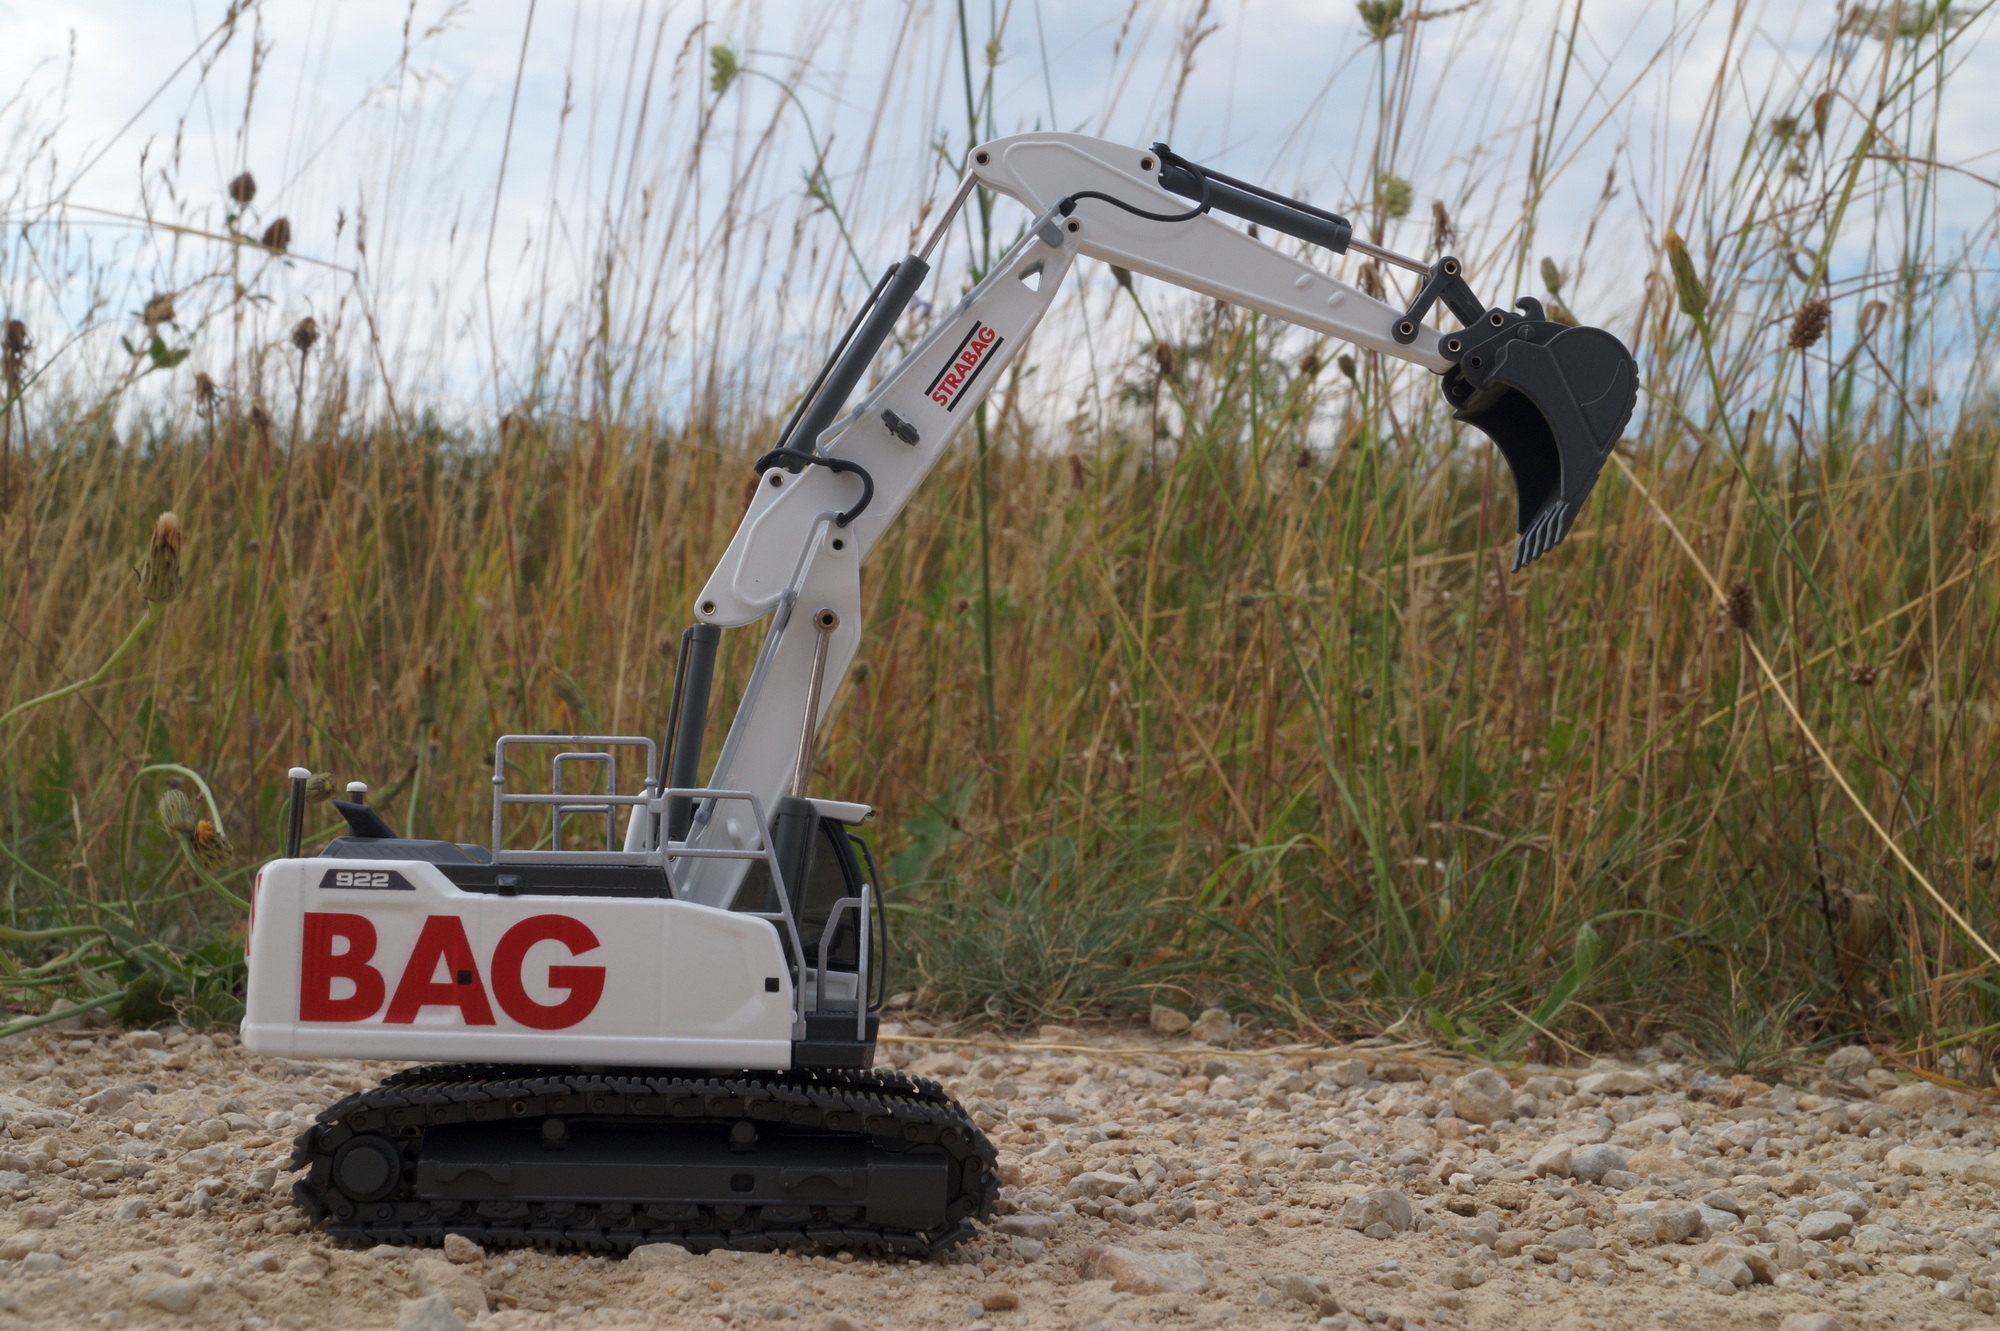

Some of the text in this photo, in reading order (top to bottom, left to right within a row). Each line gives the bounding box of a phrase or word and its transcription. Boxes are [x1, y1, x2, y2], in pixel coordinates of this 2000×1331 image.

[932, 326, 996, 407] STRABAG
[335, 871, 389, 888] 922
[299, 912, 606, 1030] BAG
